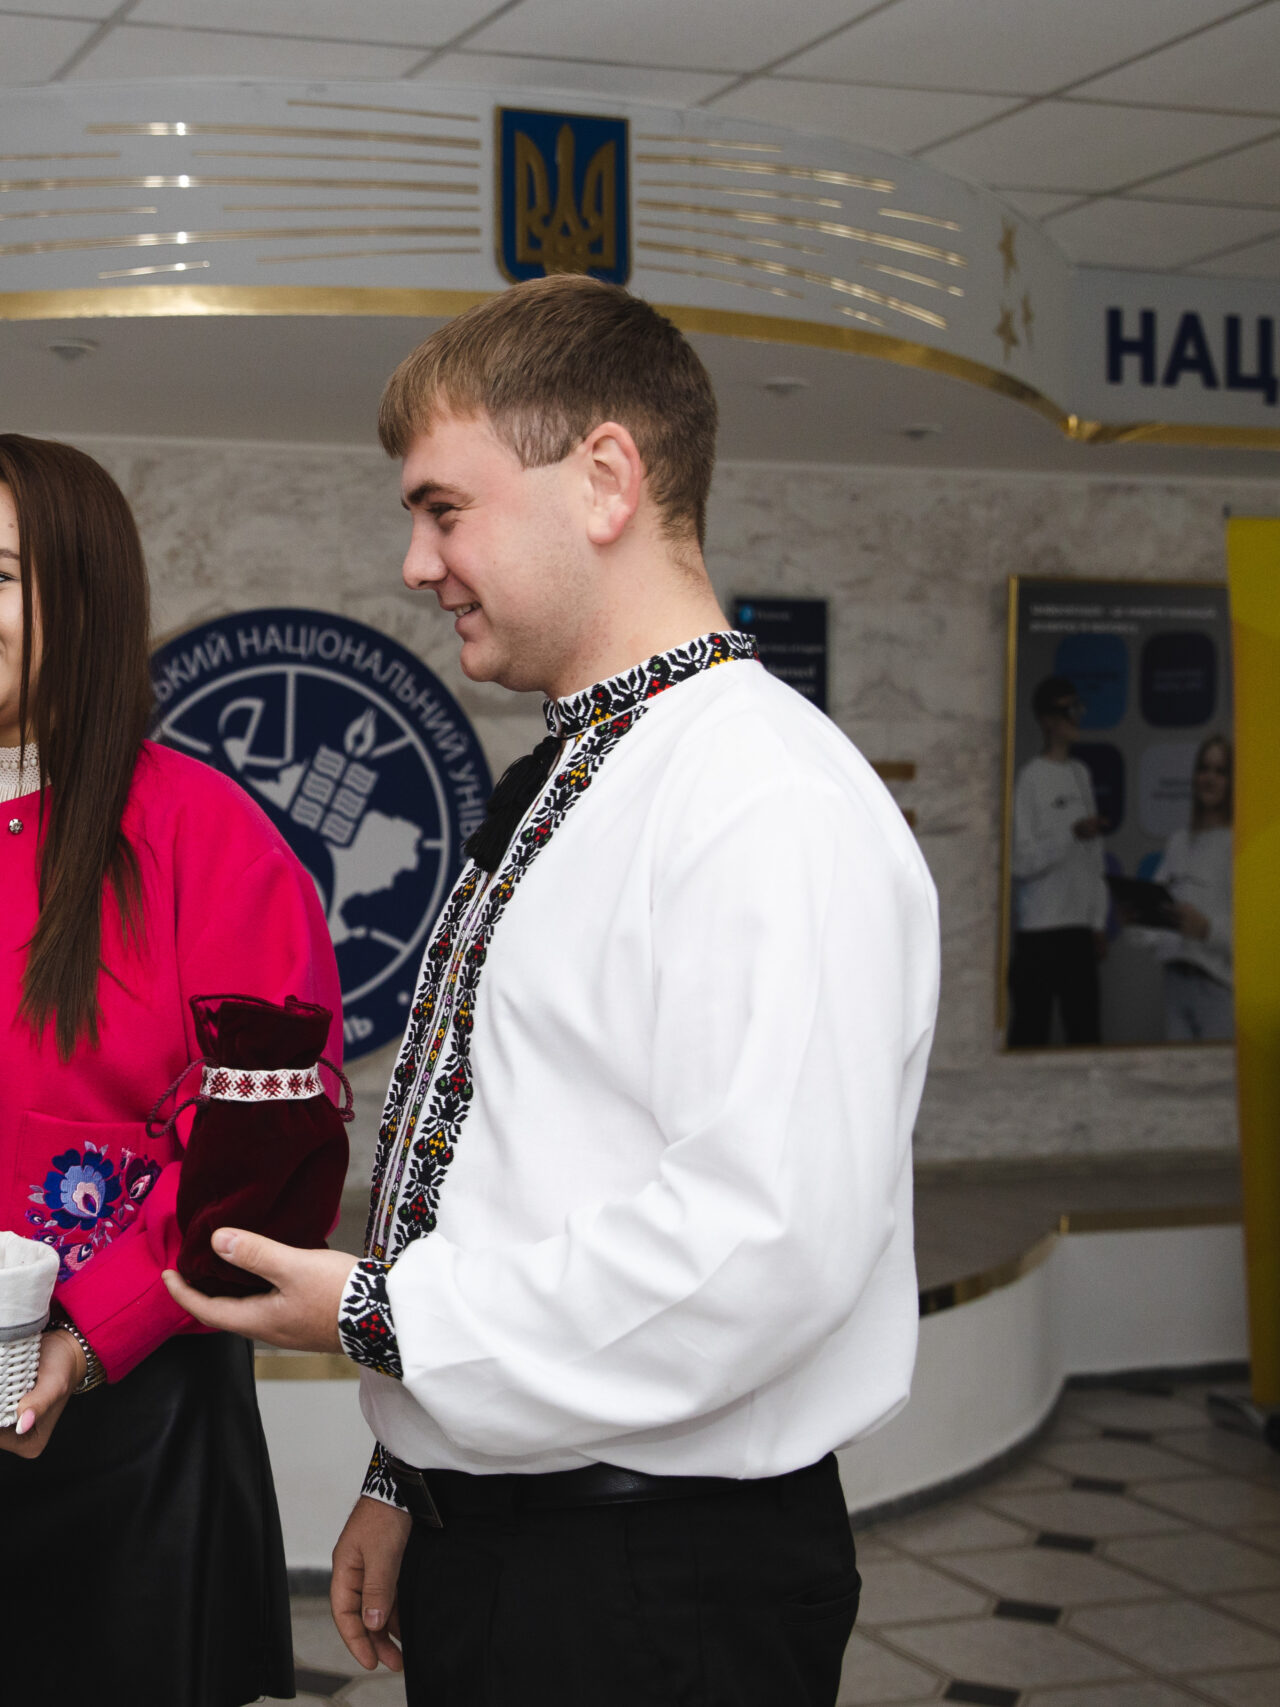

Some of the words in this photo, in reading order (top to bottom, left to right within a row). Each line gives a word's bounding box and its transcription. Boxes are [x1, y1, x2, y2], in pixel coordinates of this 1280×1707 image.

[1106, 307, 1279, 406] НАЦ
[236, 624, 469, 763] НАЦІОНАЛЬНИЙ
[447, 762, 488, 862] УНІВ
